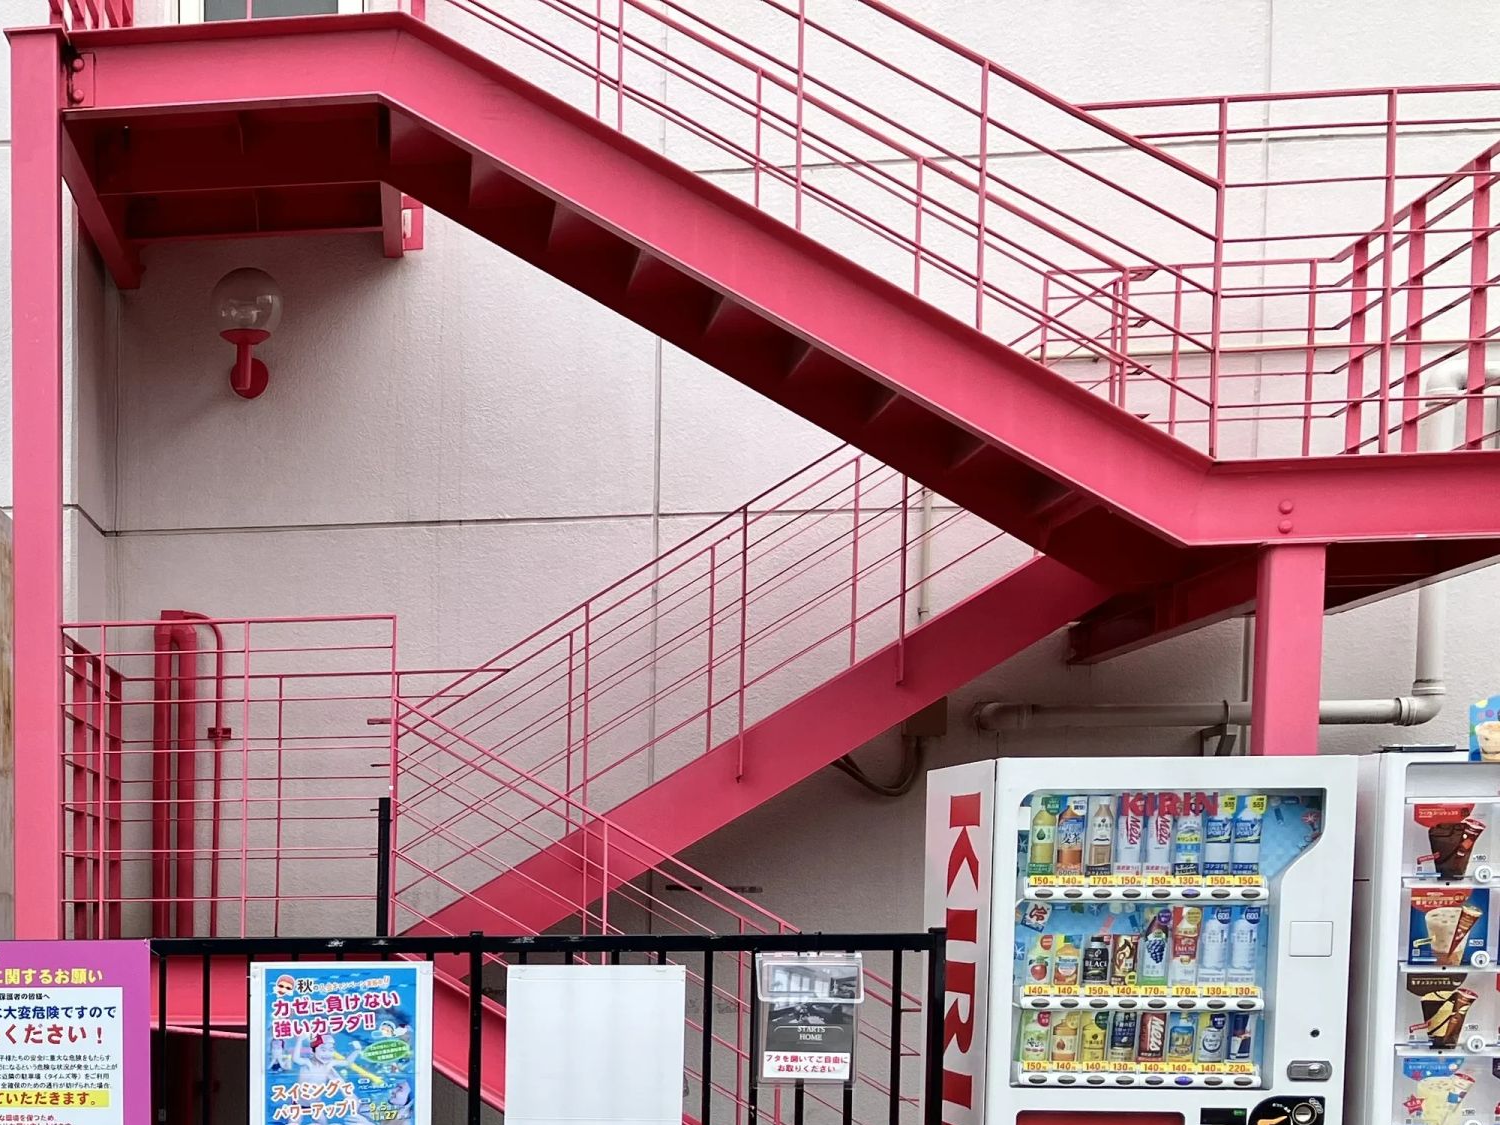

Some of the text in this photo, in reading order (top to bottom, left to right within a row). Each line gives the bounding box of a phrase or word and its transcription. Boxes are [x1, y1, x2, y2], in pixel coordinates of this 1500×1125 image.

[1120, 792, 1218, 816] KIRIN
[273, 992, 399, 1017] カゼに負けない
[273, 1081, 353, 1100] スイミングで
